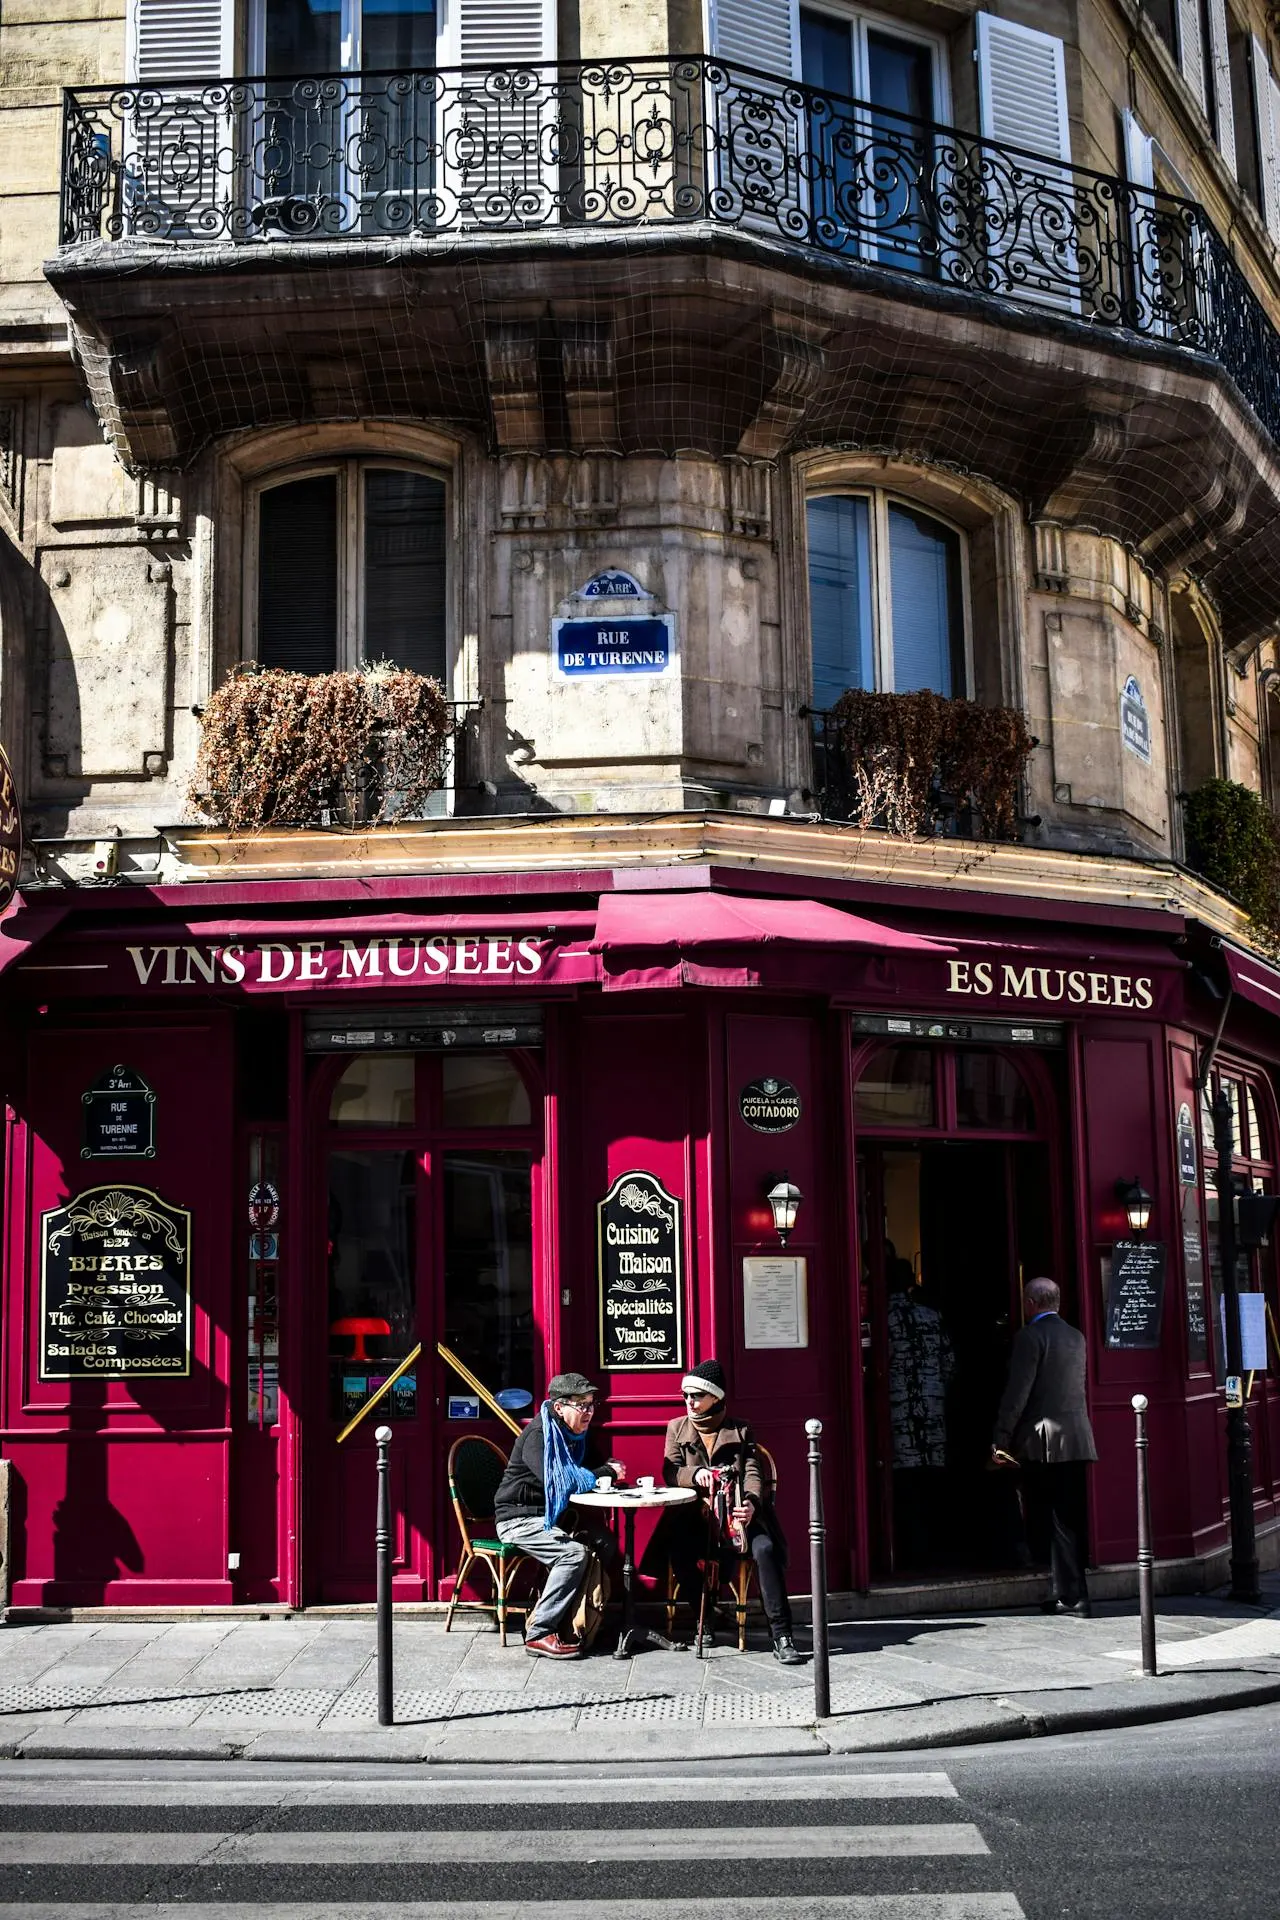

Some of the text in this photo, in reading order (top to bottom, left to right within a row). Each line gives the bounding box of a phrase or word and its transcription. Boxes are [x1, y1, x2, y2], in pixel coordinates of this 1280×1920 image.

[597, 631, 630, 645] RUE
[563, 651, 665, 667] DE TURENNE
[125, 936, 543, 985] VINS DE MUSEES
[1000, 964, 1154, 1010] MUSEES
[110, 1102, 128, 1112] RUE
[743, 1105, 800, 1118] COSTADORO
[99, 1124, 138, 1135] TURENNE
[80, 1229, 109, 1241] Maison
[606, 1222, 660, 1246] Cuisine
[102, 1237, 131, 1248] 1924
[618, 1252, 673, 1275] Maison
[119, 1271, 136, 1281] la
[66, 1283, 165, 1295] Pression
[606, 1299, 674, 1319] Spécialités
[124, 1309, 183, 1325] Chocolat
[634, 1317, 646, 1327] de
[615, 1327, 666, 1343] Viandes
[47, 1343, 118, 1356] Salades
[83, 1354, 182, 1370] Composées
